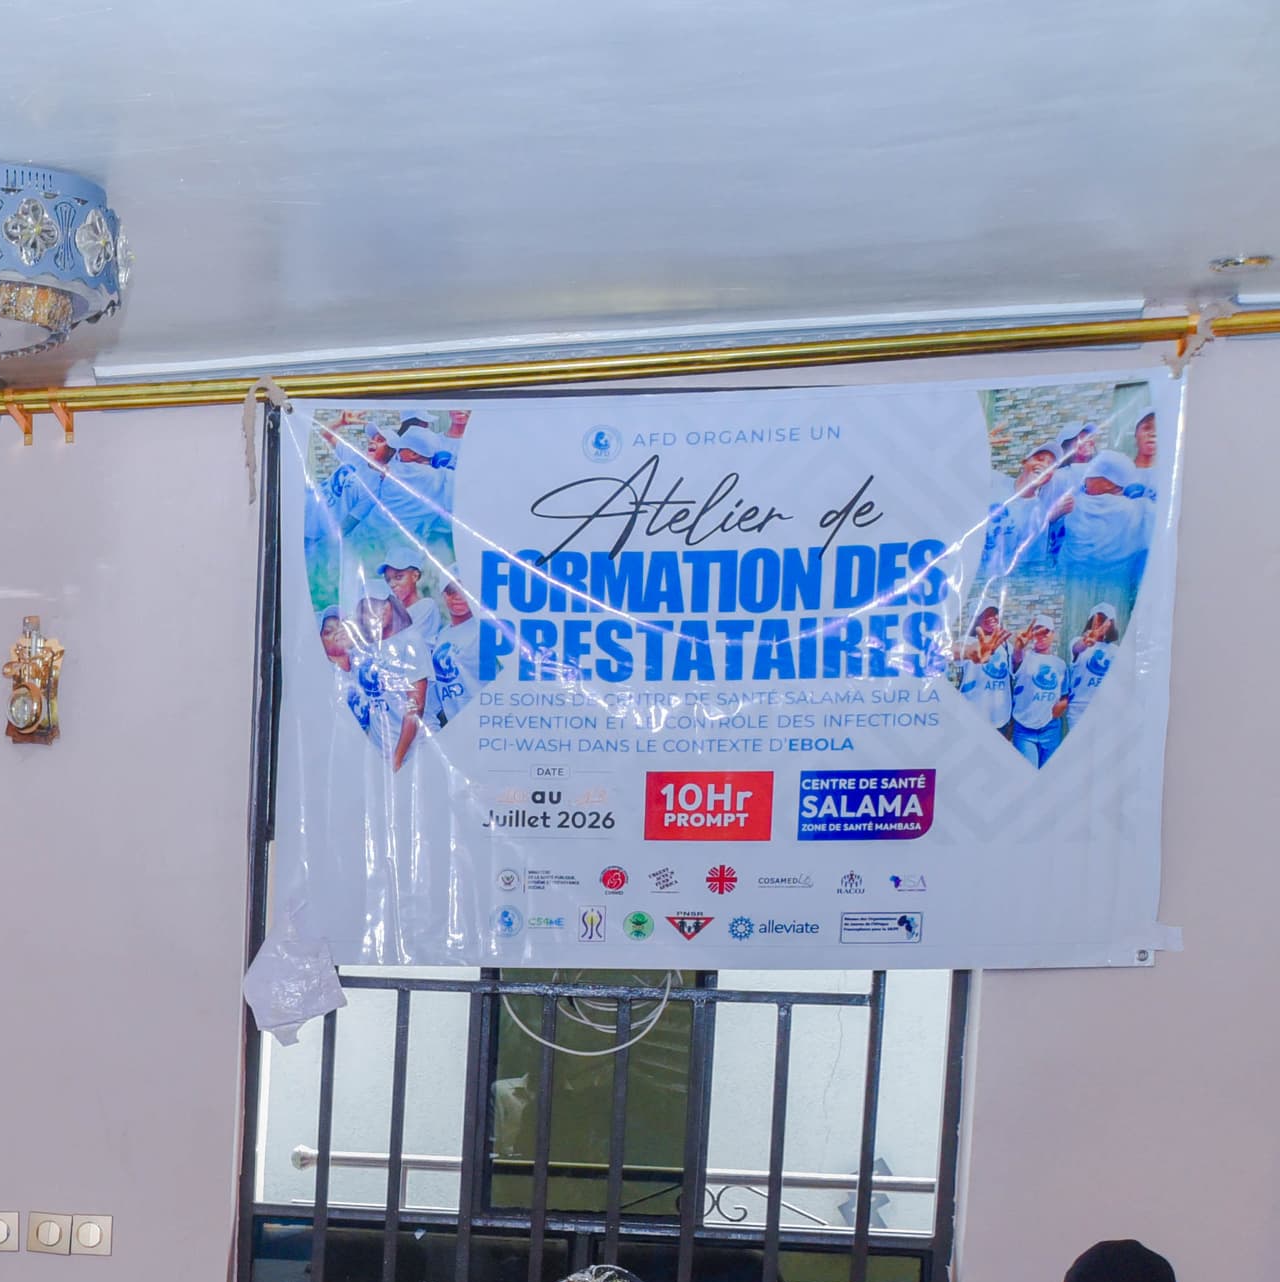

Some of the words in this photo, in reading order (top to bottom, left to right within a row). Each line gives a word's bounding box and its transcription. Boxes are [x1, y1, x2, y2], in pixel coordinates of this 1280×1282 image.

[633, 431, 677, 447] AFD
[686, 427, 801, 446] ORGANISE
[810, 425, 840, 441] UN
[531, 454, 793, 567] Atelier
[819, 475, 883, 559] de
[480, 545, 824, 613] FORMATION
[833, 539, 948, 606] DES
[478, 612, 946, 682] PRESTATAIRES
[480, 692, 504, 706] DE
[510, 692, 565, 707] SOINS
[685, 692, 709, 706] DE
[716, 689, 779, 705] SANTÉ
[784, 689, 865, 705] SALAMA
[871, 689, 911, 704] SUR
[917, 688, 941, 703] LA
[1033, 691, 1056, 700] AFD
[479, 712, 597, 729] PRÉVENTION
[606, 716, 625, 729] ET
[777, 714, 815, 728] DES
[823, 712, 940, 727] INFECTIONS
[478, 738, 571, 752] PCI-WASH
[578, 738, 630, 753] DANS
[636, 738, 657, 752] LE
[663, 738, 762, 753] CONTEXTE
[769, 737, 854, 752] D'EBOLA
[536, 768, 564, 776] DATE
[801, 777, 856, 790] CENTRE
[859, 777, 877, 790] DE
[880, 774, 926, 789] SANTÉ
[531, 791, 562, 804] au
[660, 783, 753, 811] 10Hr
[801, 794, 924, 818] SALAMA
[482, 810, 550, 828] Juillet
[557, 811, 616, 829] 2026
[664, 812, 749, 827] PROMPT
[801, 823, 827, 832] ZONE
[829, 823, 841, 832] DE
[843, 821, 873, 831] SANTÉ
[875, 822, 921, 831] MAMBASA
[759, 920, 819, 934] alleviate
